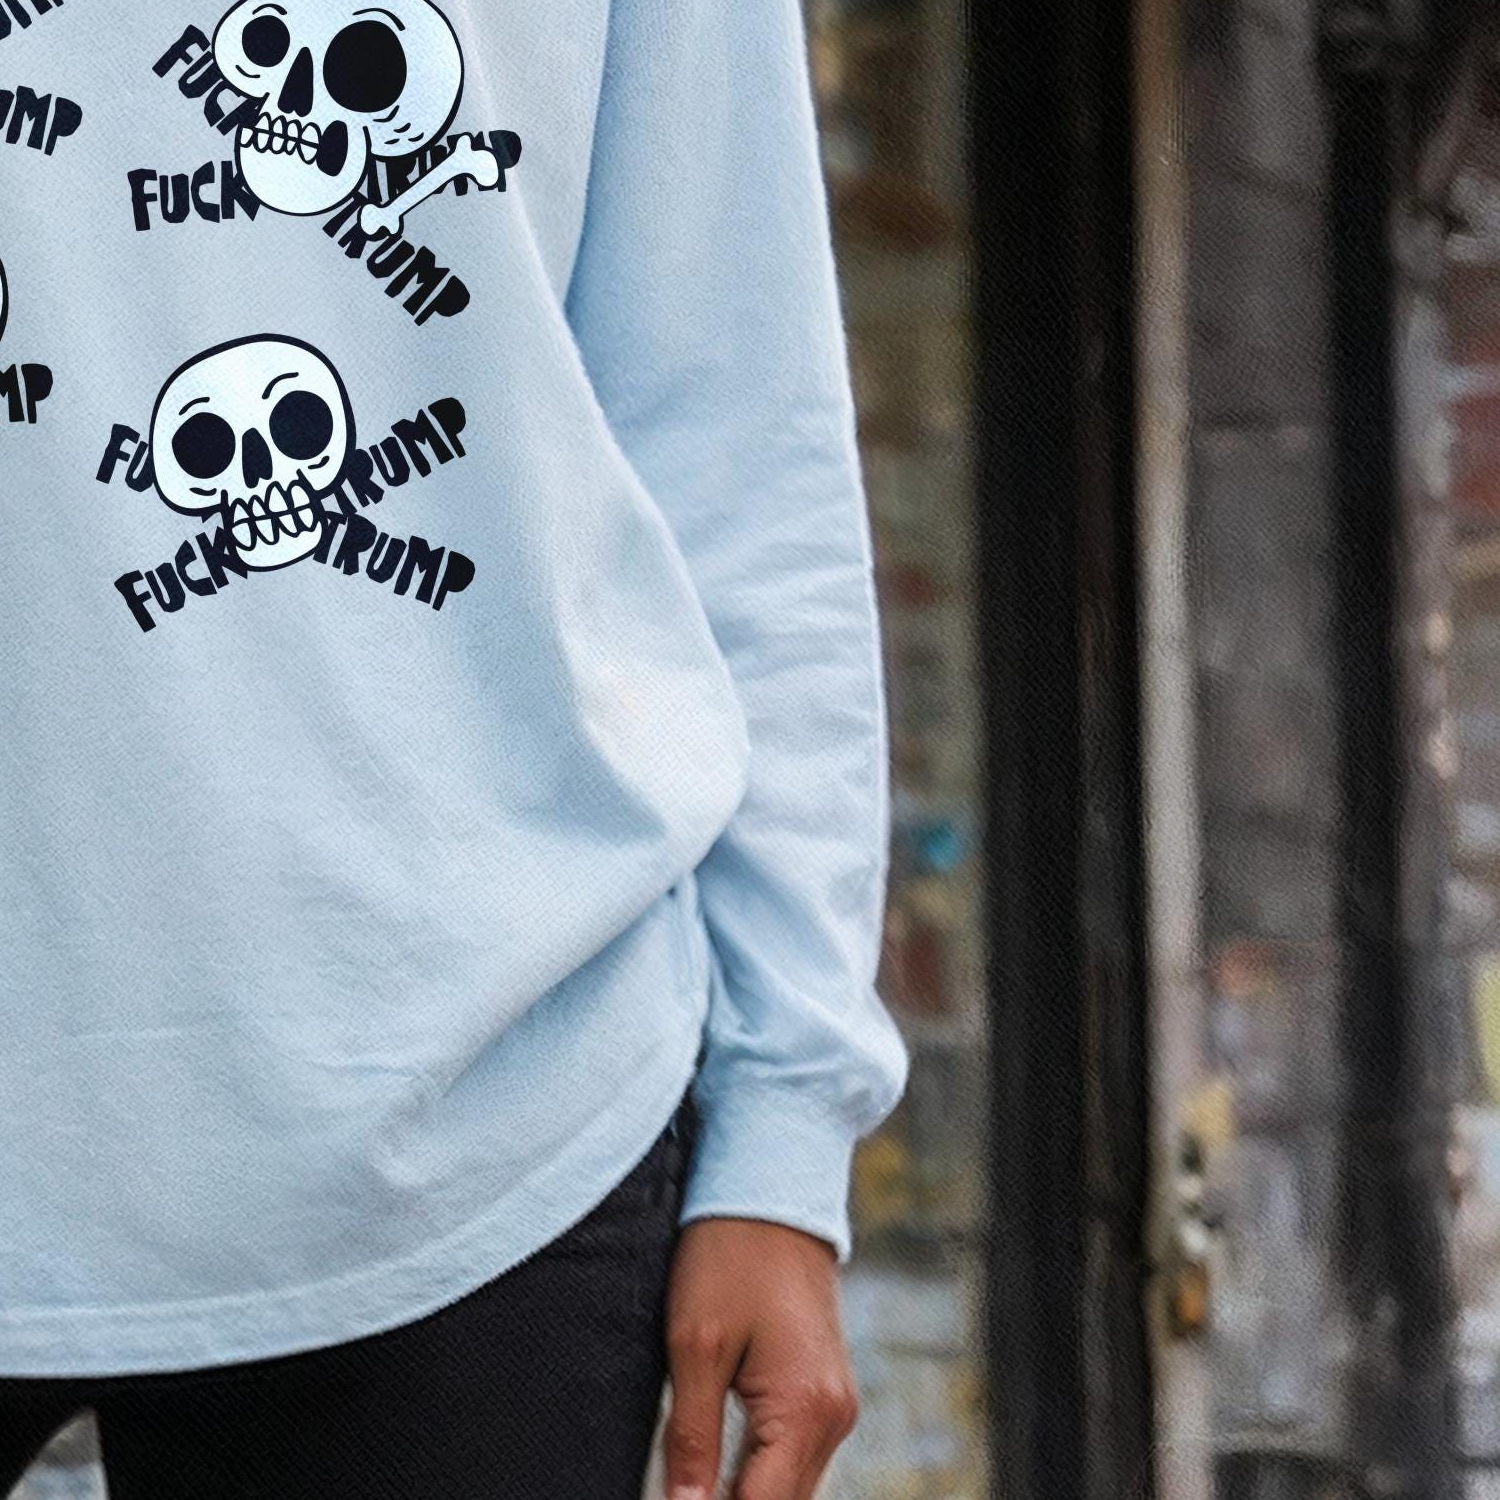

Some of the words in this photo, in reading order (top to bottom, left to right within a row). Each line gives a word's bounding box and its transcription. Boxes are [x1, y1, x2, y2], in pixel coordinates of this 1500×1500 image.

[127, 161, 260, 231] FUCK
[96, 423, 154, 493] FU
[314, 511, 476, 611] TRUMP
[114, 526, 248, 633] FUCK
